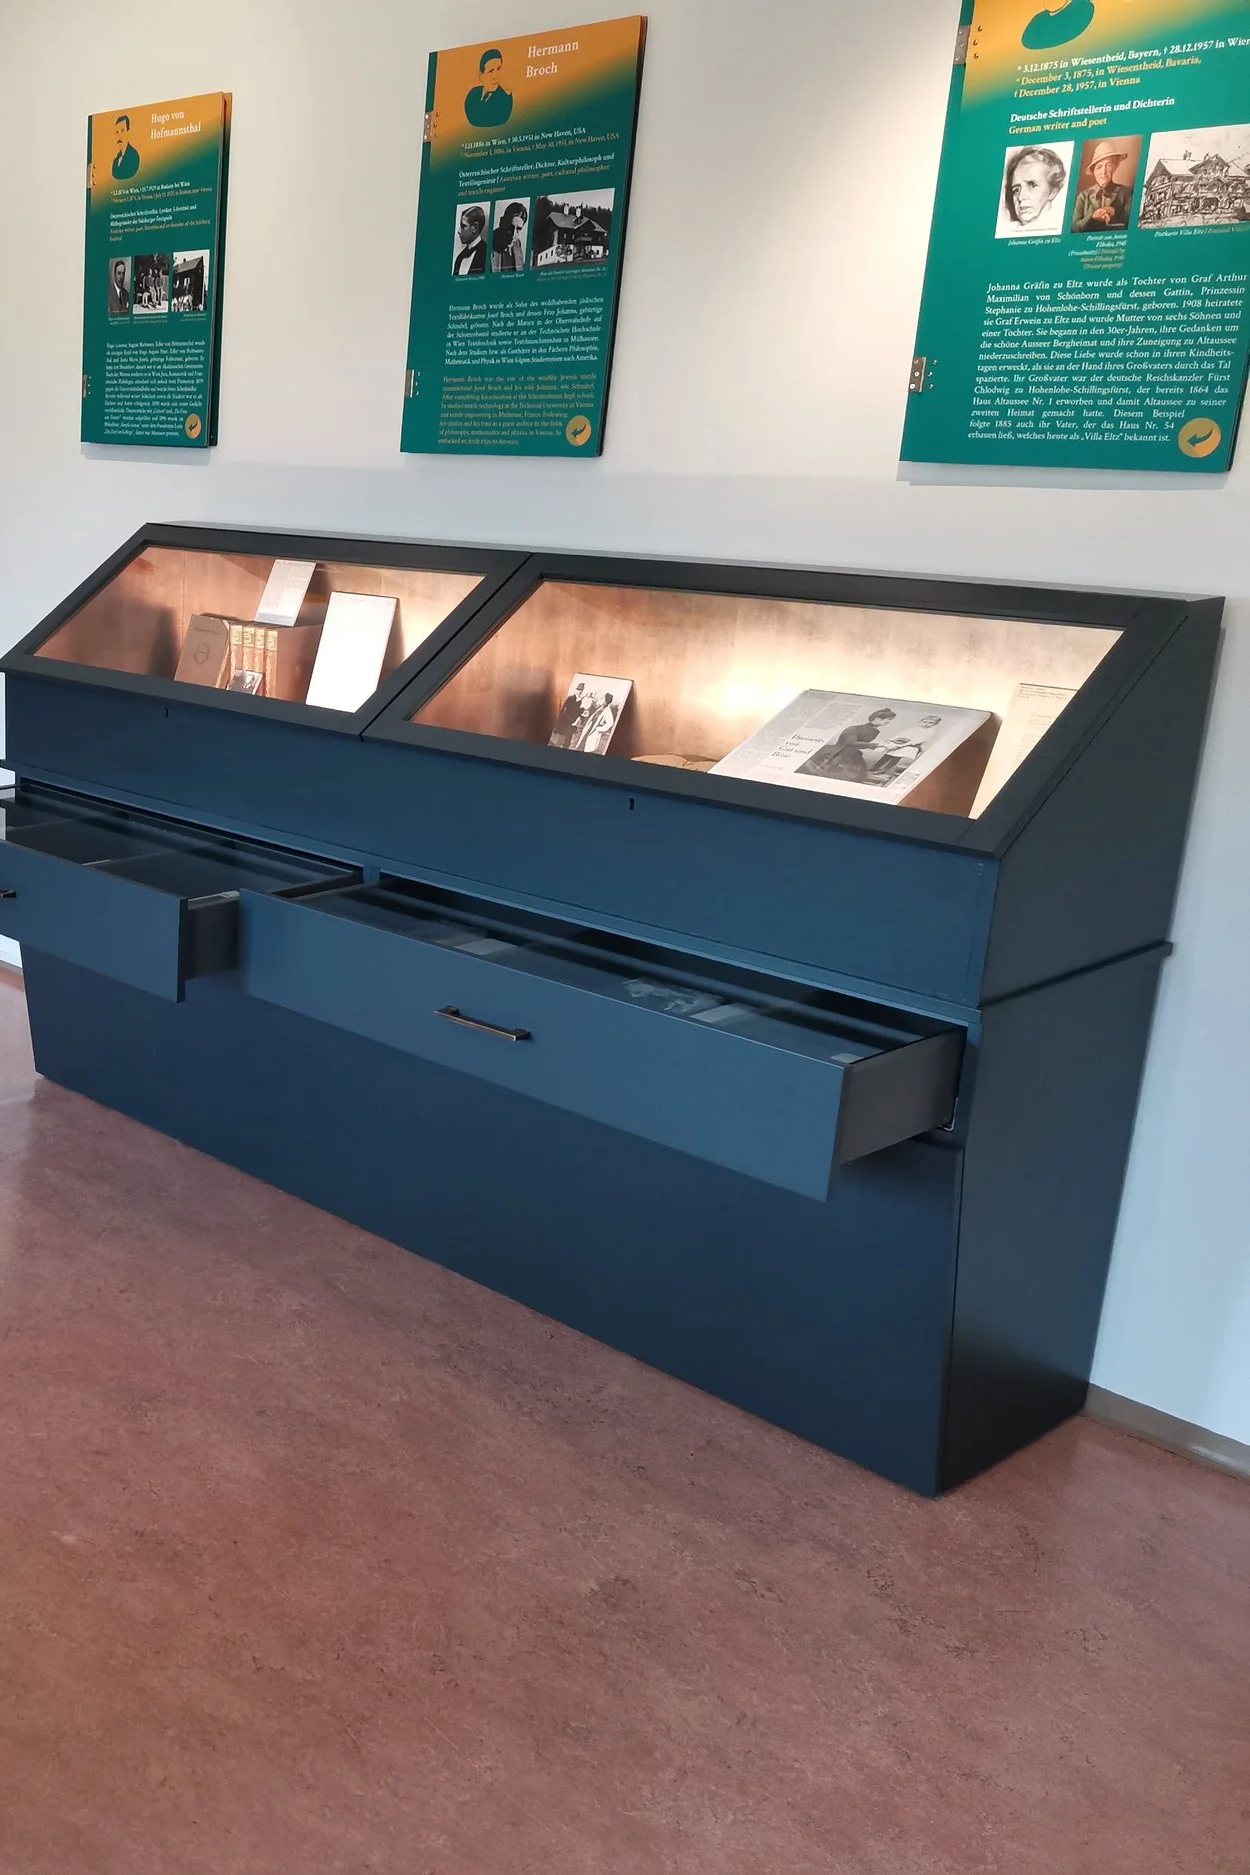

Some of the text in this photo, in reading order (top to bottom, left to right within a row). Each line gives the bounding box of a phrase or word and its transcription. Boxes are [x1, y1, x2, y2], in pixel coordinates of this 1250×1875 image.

[528, 42, 578, 58] Hermann
[1022, 60, 1059, 73] 3.12.1875
[1060, 60, 1068, 69] in
[1071, 52, 1126, 67] Wiesentheid,
[1128, 48, 1161, 61] Bayern,
[1170, 40, 1214, 54] 28.12.1957
[1216, 40, 1225, 49] in
[526, 62, 558, 78] Broch
[1021, 72, 1062, 86] December
[1064, 71, 1071, 80] 3,
[1073, 68, 1094, 79] 1875,
[1096, 68, 1105, 76] in
[1107, 58, 1164, 74] Wiesentheid,
[1166, 56, 1201, 68] Bavaria,
[1019, 84, 1059, 98] December
[1062, 83, 1074, 94] 28,
[1076, 80, 1097, 92] 1957,
[1098, 80, 1107, 88] in
[1110, 76, 1141, 86] Vienna
[152, 112, 185, 124] Hugo von
[1010, 96, 1175, 123] Deutsche Schriftstellerin und Dichterin
[151, 121, 201, 139] Hofmannsthal
[574, 127, 586, 135] USA
[1009, 118, 1107, 134] German writer and poet
[459, 168, 499, 178] Österreichischer
[500, 163, 535, 173] Schriftsteller,
[558, 154, 602, 166] Kulturphilosoph
[603, 152, 614, 160] und
[986, 283, 1020, 292] Johanna
[1023, 280, 1049, 290] Gräfin
[1066, 279, 1082, 288] Eltz
[1086, 278, 1112, 286] wurde
[1115, 277, 1128, 286] als
[1132, 276, 1166, 285] Tochter
[1190, 274, 1213, 282] Graf
[1215, 272, 1246, 282] Arthur
[986, 294, 1029, 302] Maximilian
[1056, 291, 1099, 300] Schönborn
[1106, 289, 1122, 298] und
[1129, 289, 1155, 297] dessen
[1163, 287, 1193, 296] Gattin,
[1200, 286, 1245, 295] Prinzessin
[985, 305, 1021, 316] Stephanie
[1035, 302, 1139, 312] Hohenlohe-Schillingsfürst,
[1142, 300, 1178, 311] geboren.
[1182, 299, 1202, 308] 1908
[1204, 299, 1243, 307] heiratete
